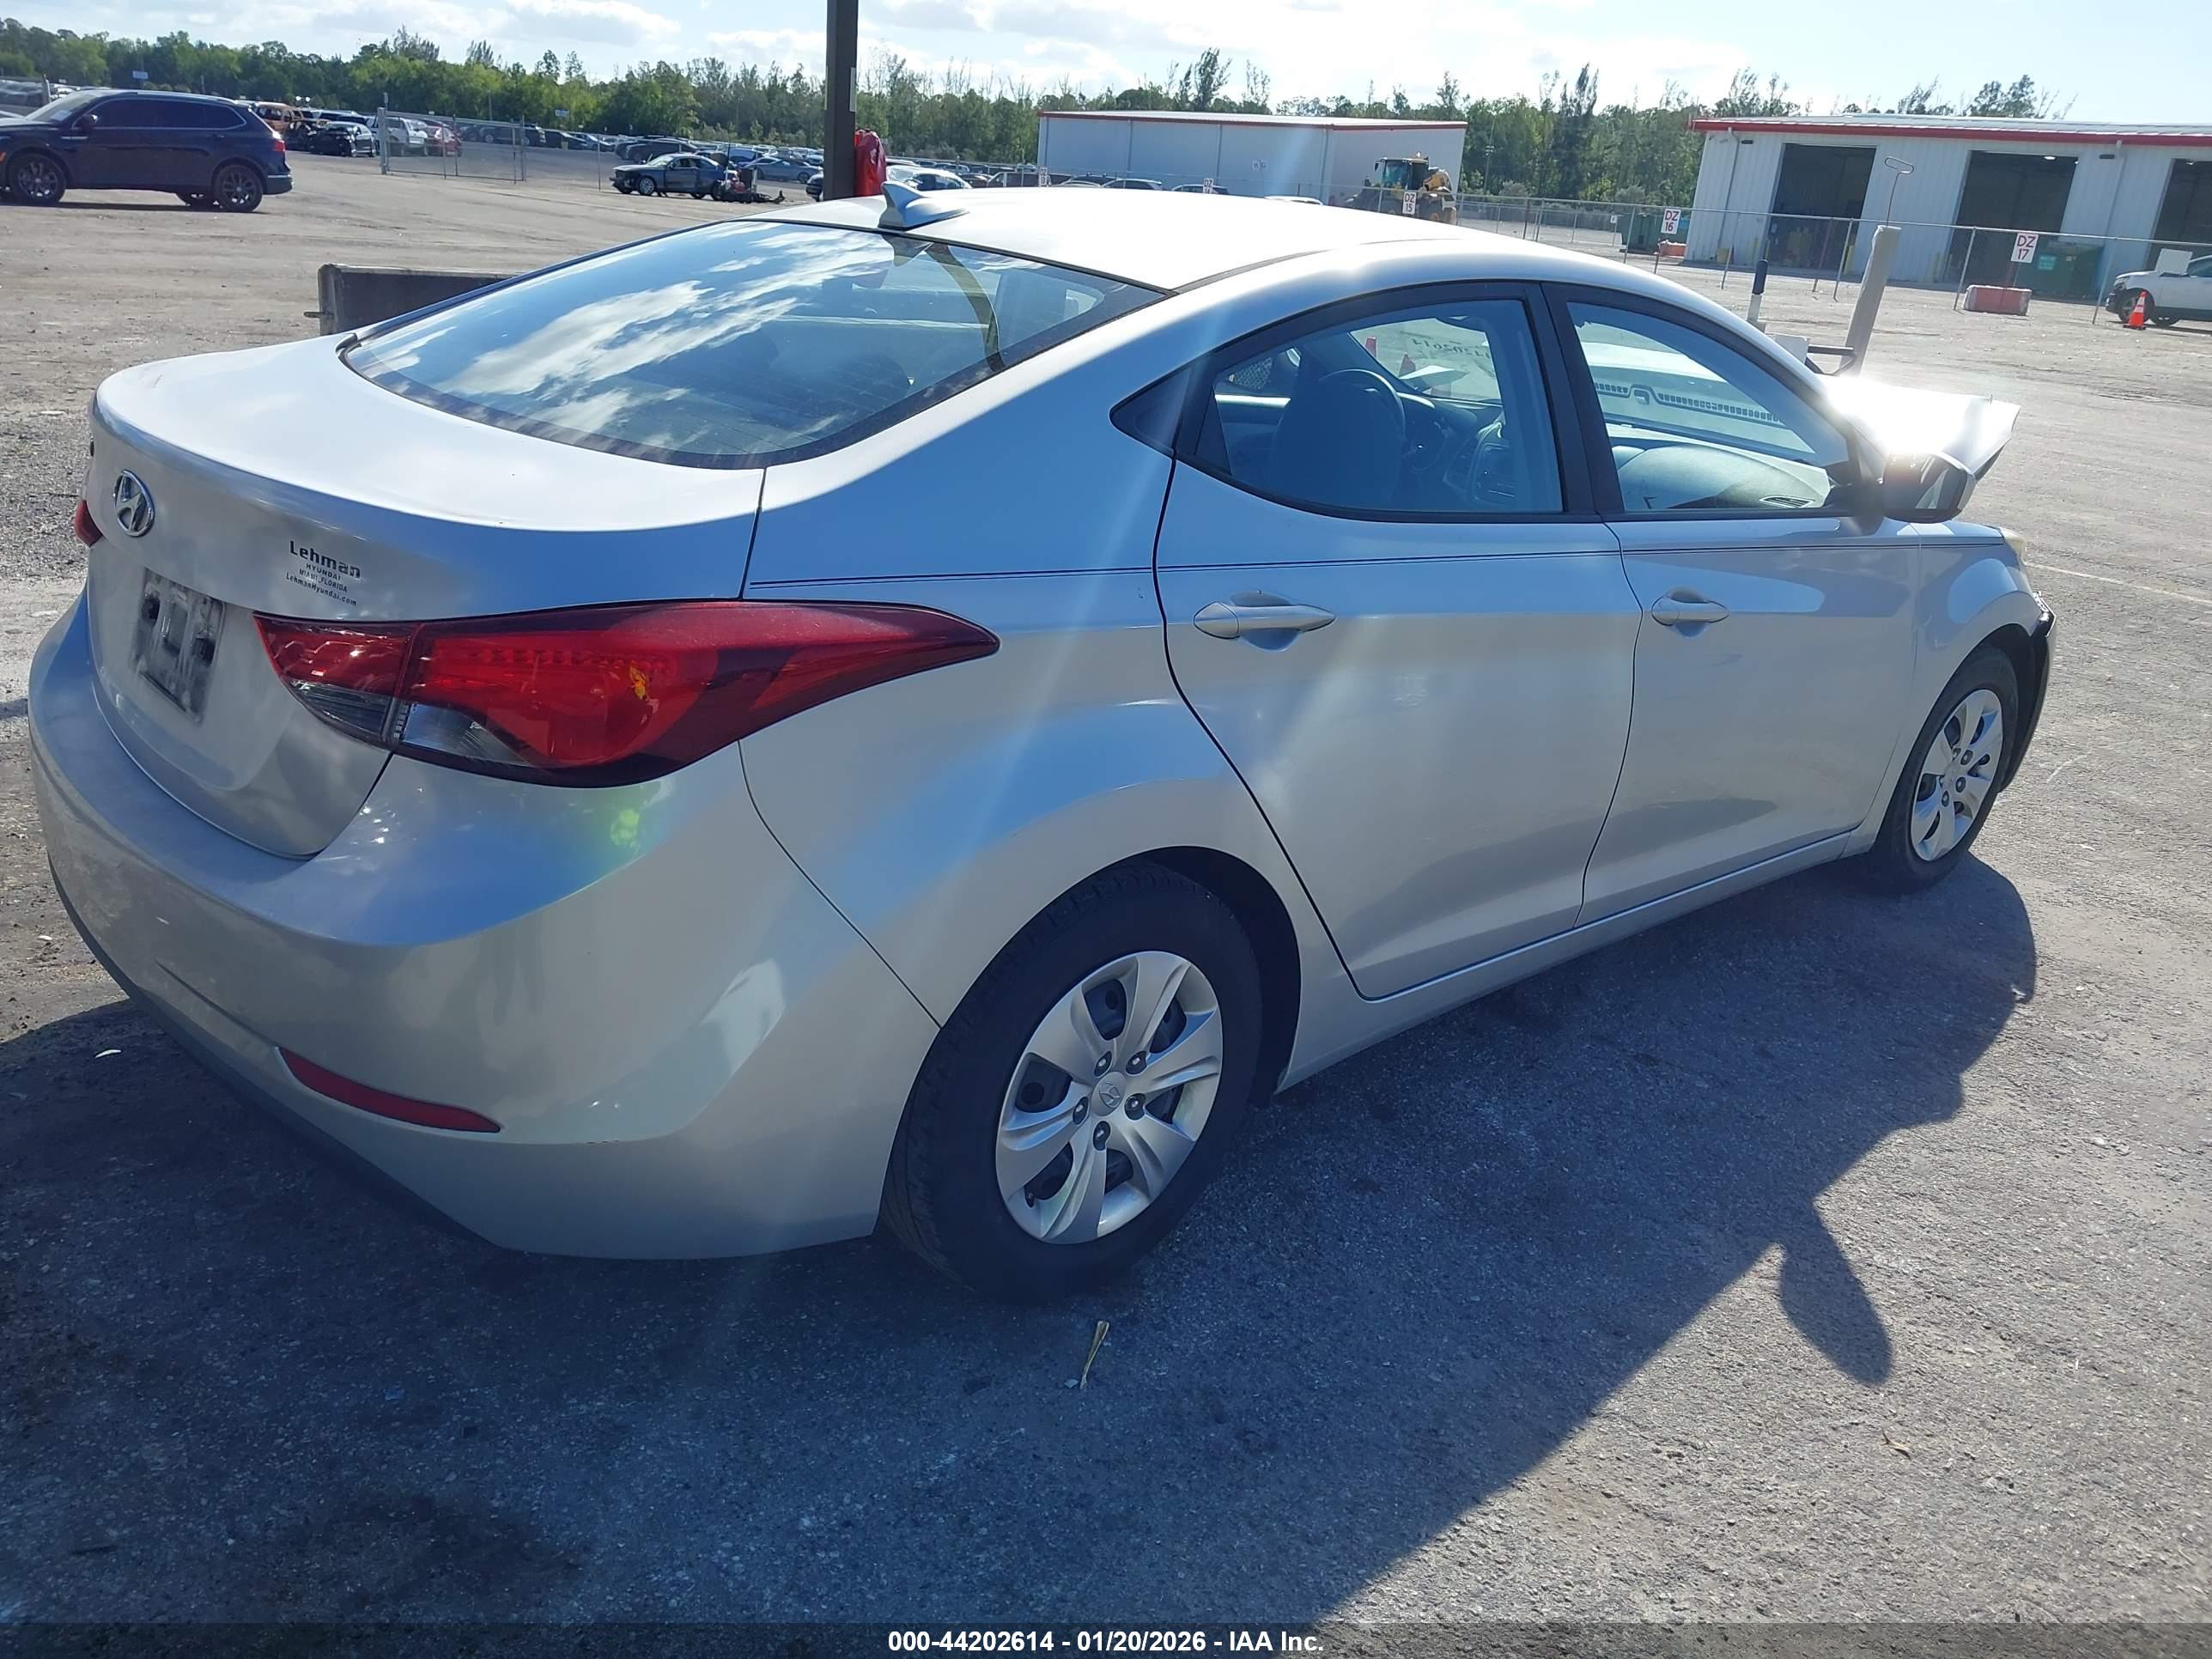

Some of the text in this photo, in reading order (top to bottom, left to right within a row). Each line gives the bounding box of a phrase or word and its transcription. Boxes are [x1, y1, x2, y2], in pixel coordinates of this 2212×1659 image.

[1405, 193, 1415, 203] DZ
[1406, 203, 1413, 212] 15
[1665, 210, 1680, 221] DZ
[1665, 222, 1674, 232] 16
[2017, 235, 2036, 247] DZ
[2018, 248, 2029, 260] 17
[289, 540, 361, 579] Lehman
[306, 562, 341, 581] HYUNDAI
[286, 572, 357, 606] LehmanHyundai.com
